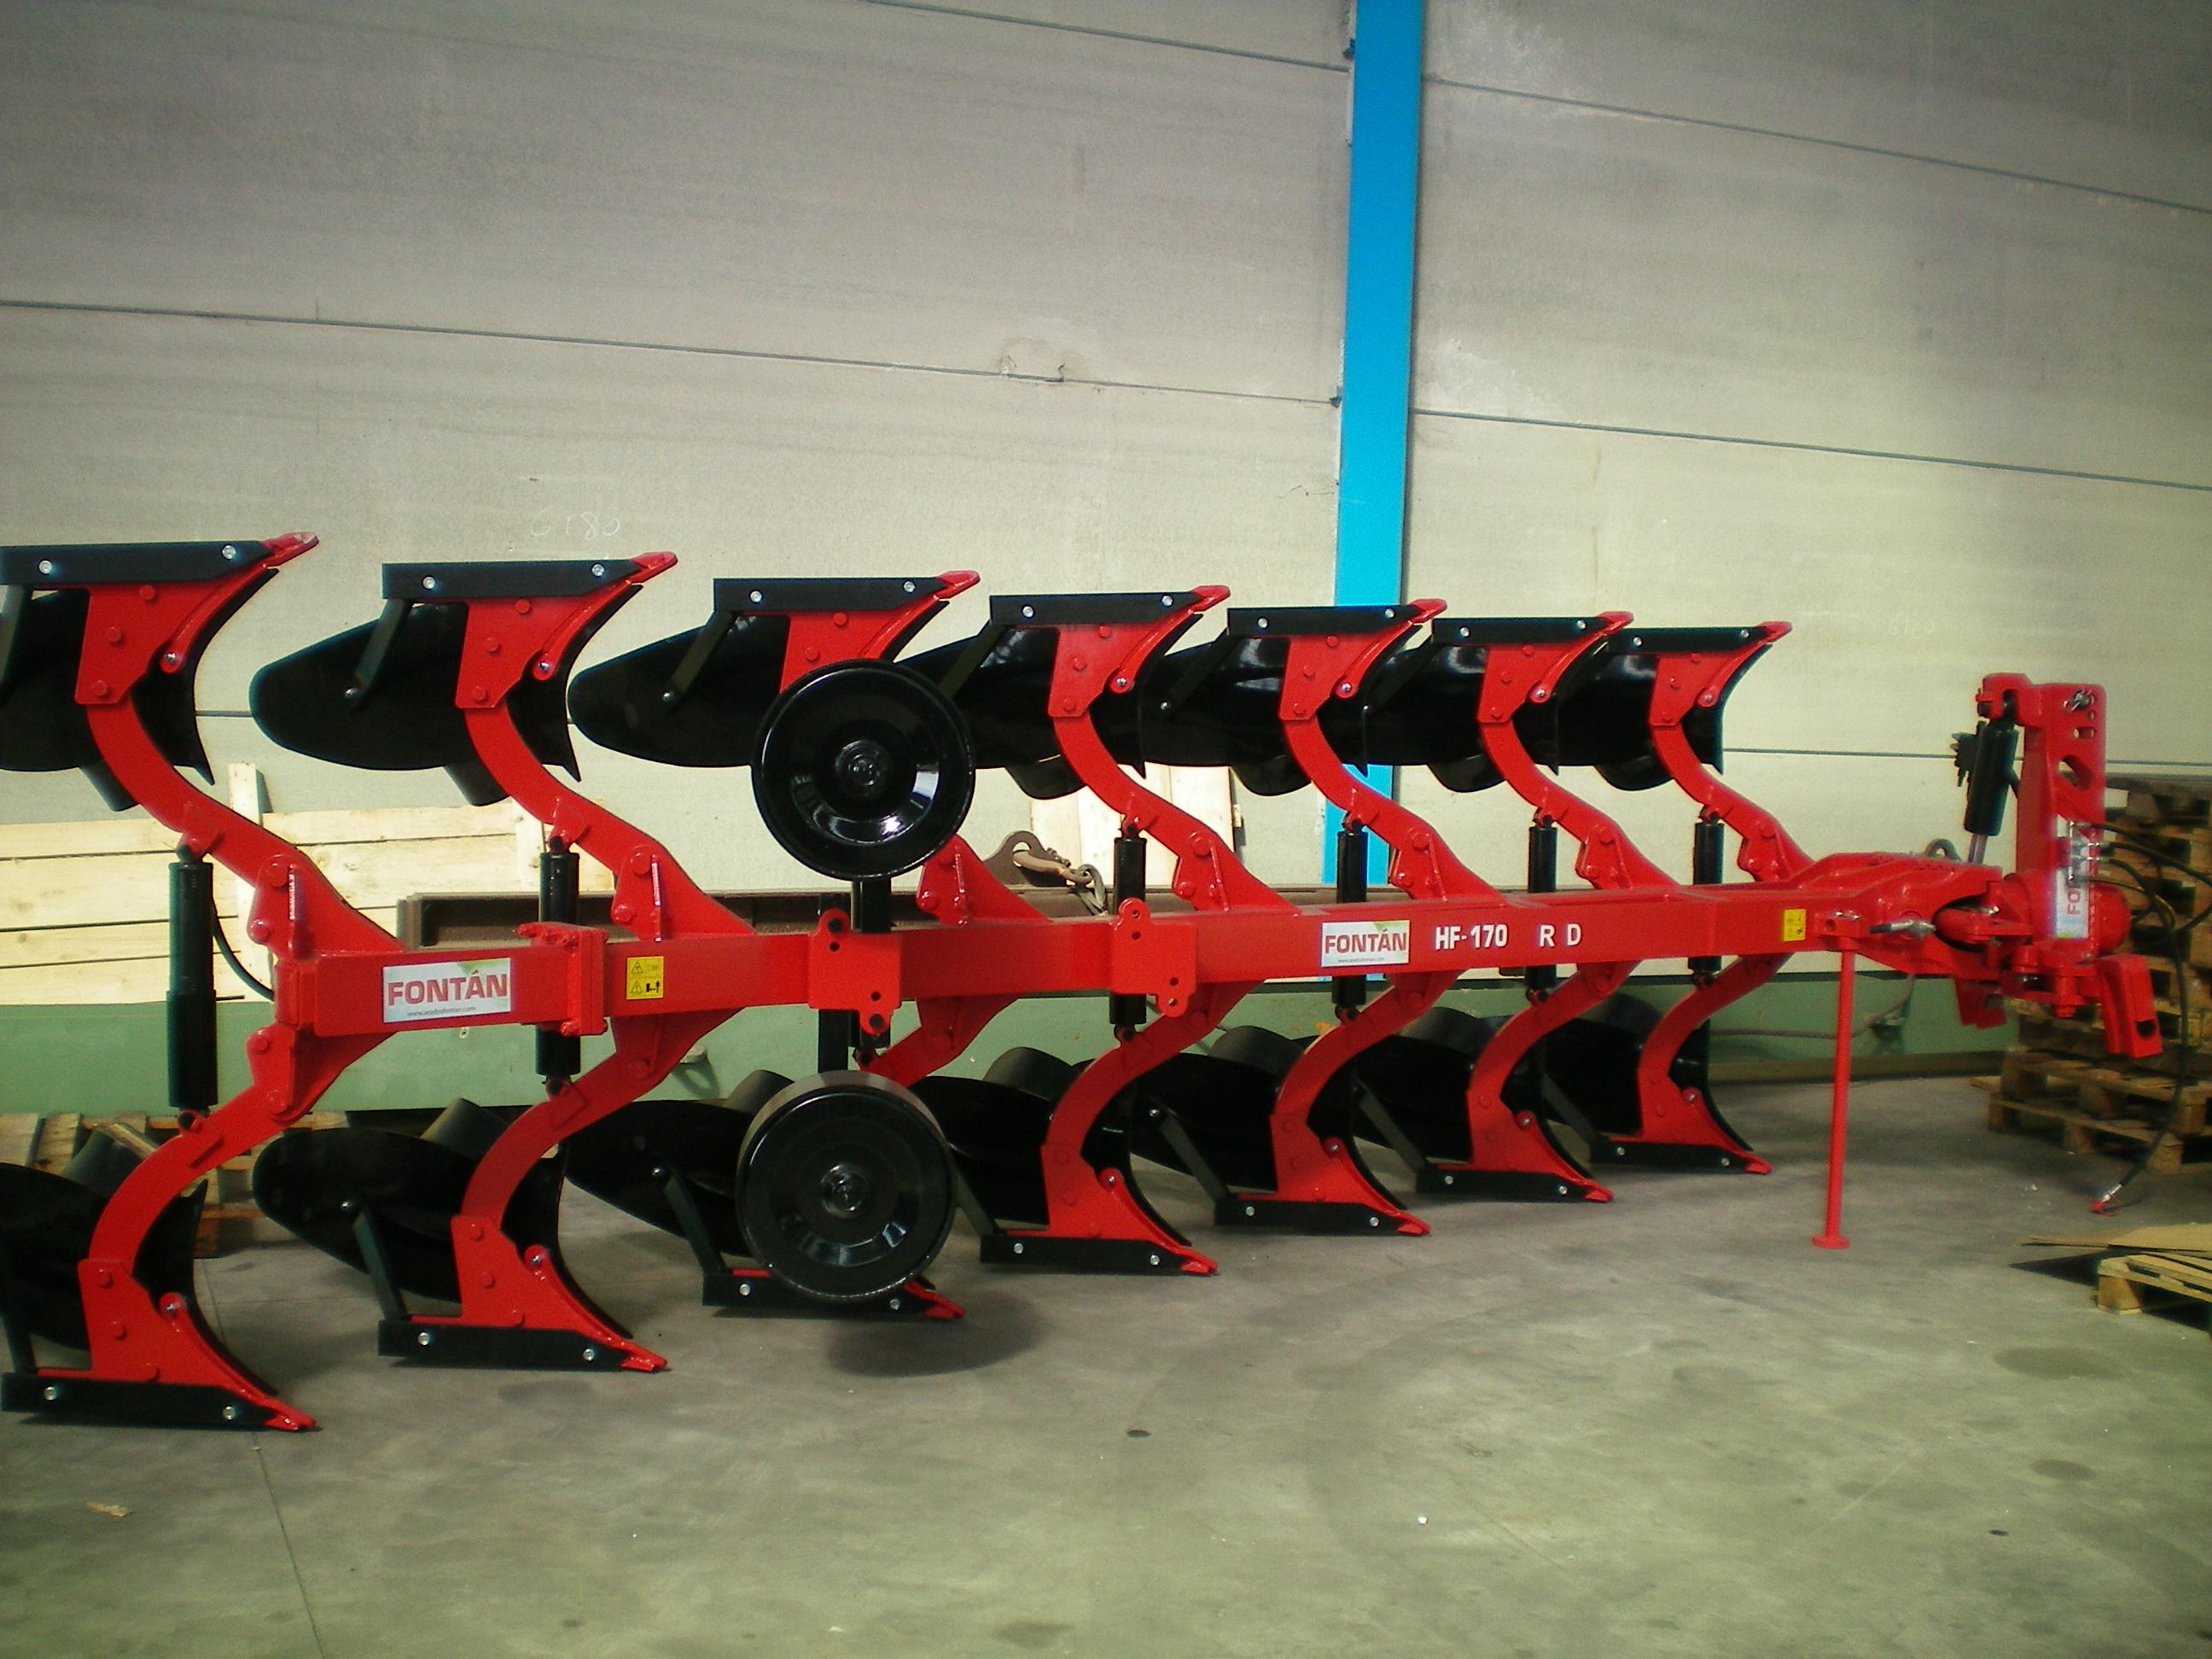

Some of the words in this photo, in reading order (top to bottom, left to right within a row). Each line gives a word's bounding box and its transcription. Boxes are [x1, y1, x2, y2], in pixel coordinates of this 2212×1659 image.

[1325, 928, 1407, 954] FONTÁN
[1435, 923, 1508, 950] HF-170
[387, 969, 508, 1006] FONTÁN
